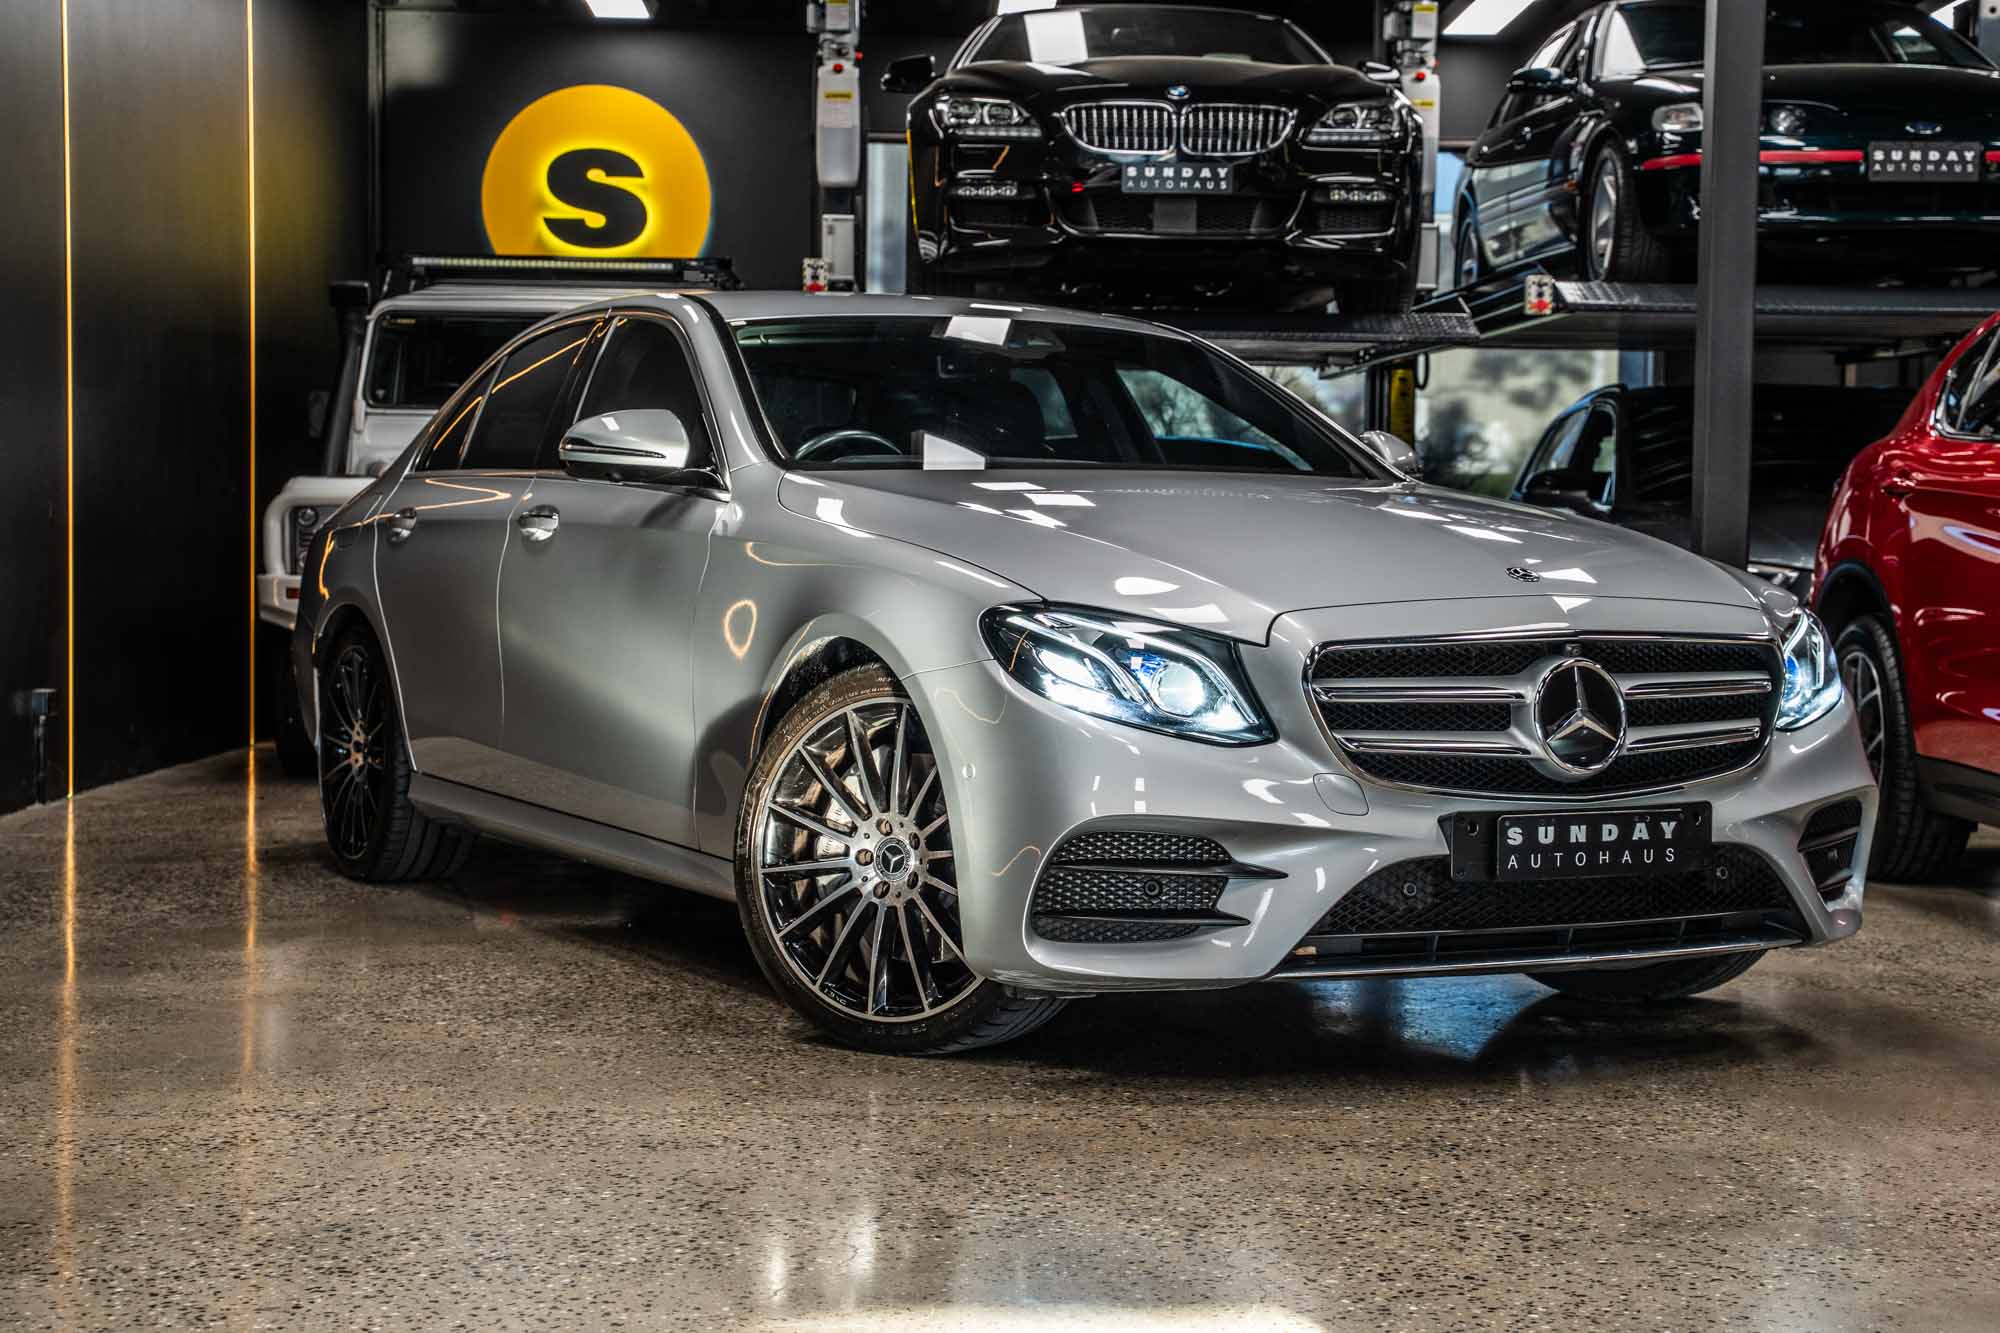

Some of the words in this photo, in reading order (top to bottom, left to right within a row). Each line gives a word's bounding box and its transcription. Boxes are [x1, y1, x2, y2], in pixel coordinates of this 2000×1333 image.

[1873, 149, 1975, 161] SUNDAY
[1126, 166, 1229, 178] SUNDAY
[1873, 162, 1974, 172] AUTOHAUS
[1127, 180, 1227, 190] AUTOHAUS
[544, 148, 647, 249] S
[1506, 821, 1677, 846] SUNDAY
[1507, 848, 1675, 869] AUTOHAUS
